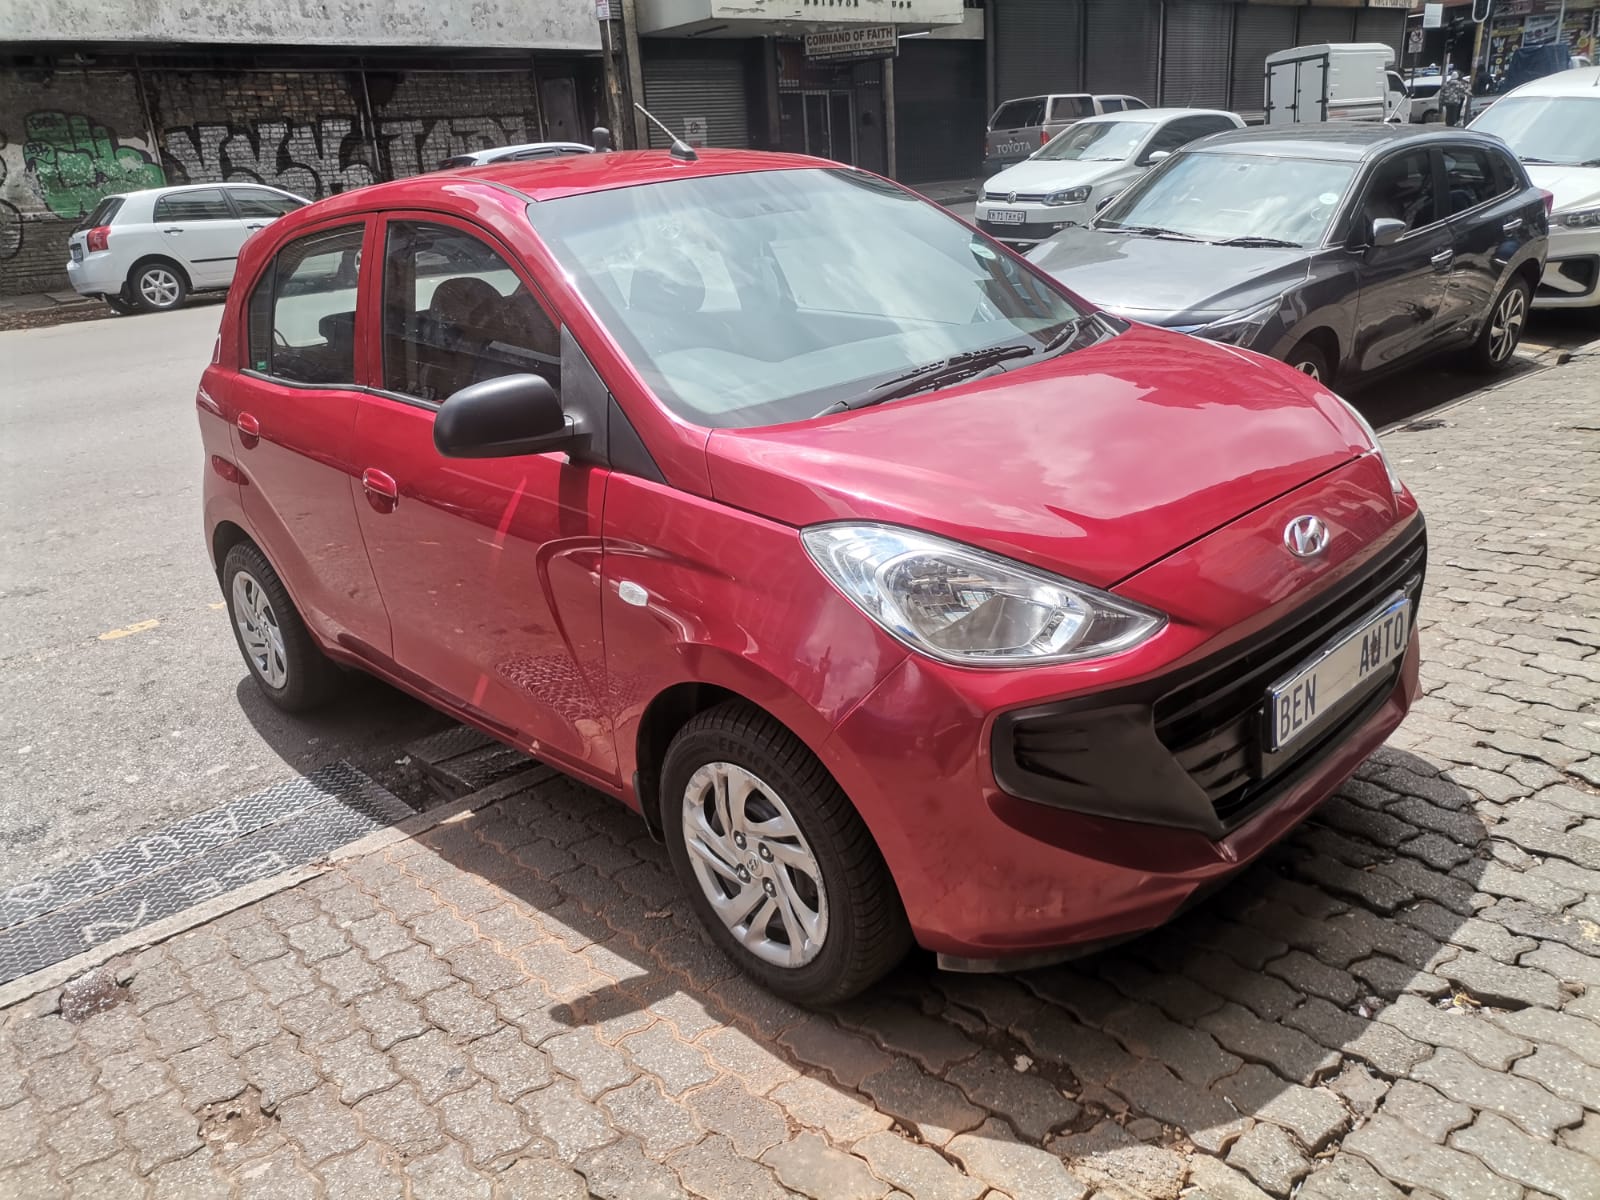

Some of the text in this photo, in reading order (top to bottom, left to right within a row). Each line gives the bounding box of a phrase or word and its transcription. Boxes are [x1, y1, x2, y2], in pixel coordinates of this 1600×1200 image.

[807, 27, 893, 46] COMMAND OF FAITH
[996, 141, 1031, 153] TOYOTA
[1280, 611, 1404, 742] BEN AUTO
